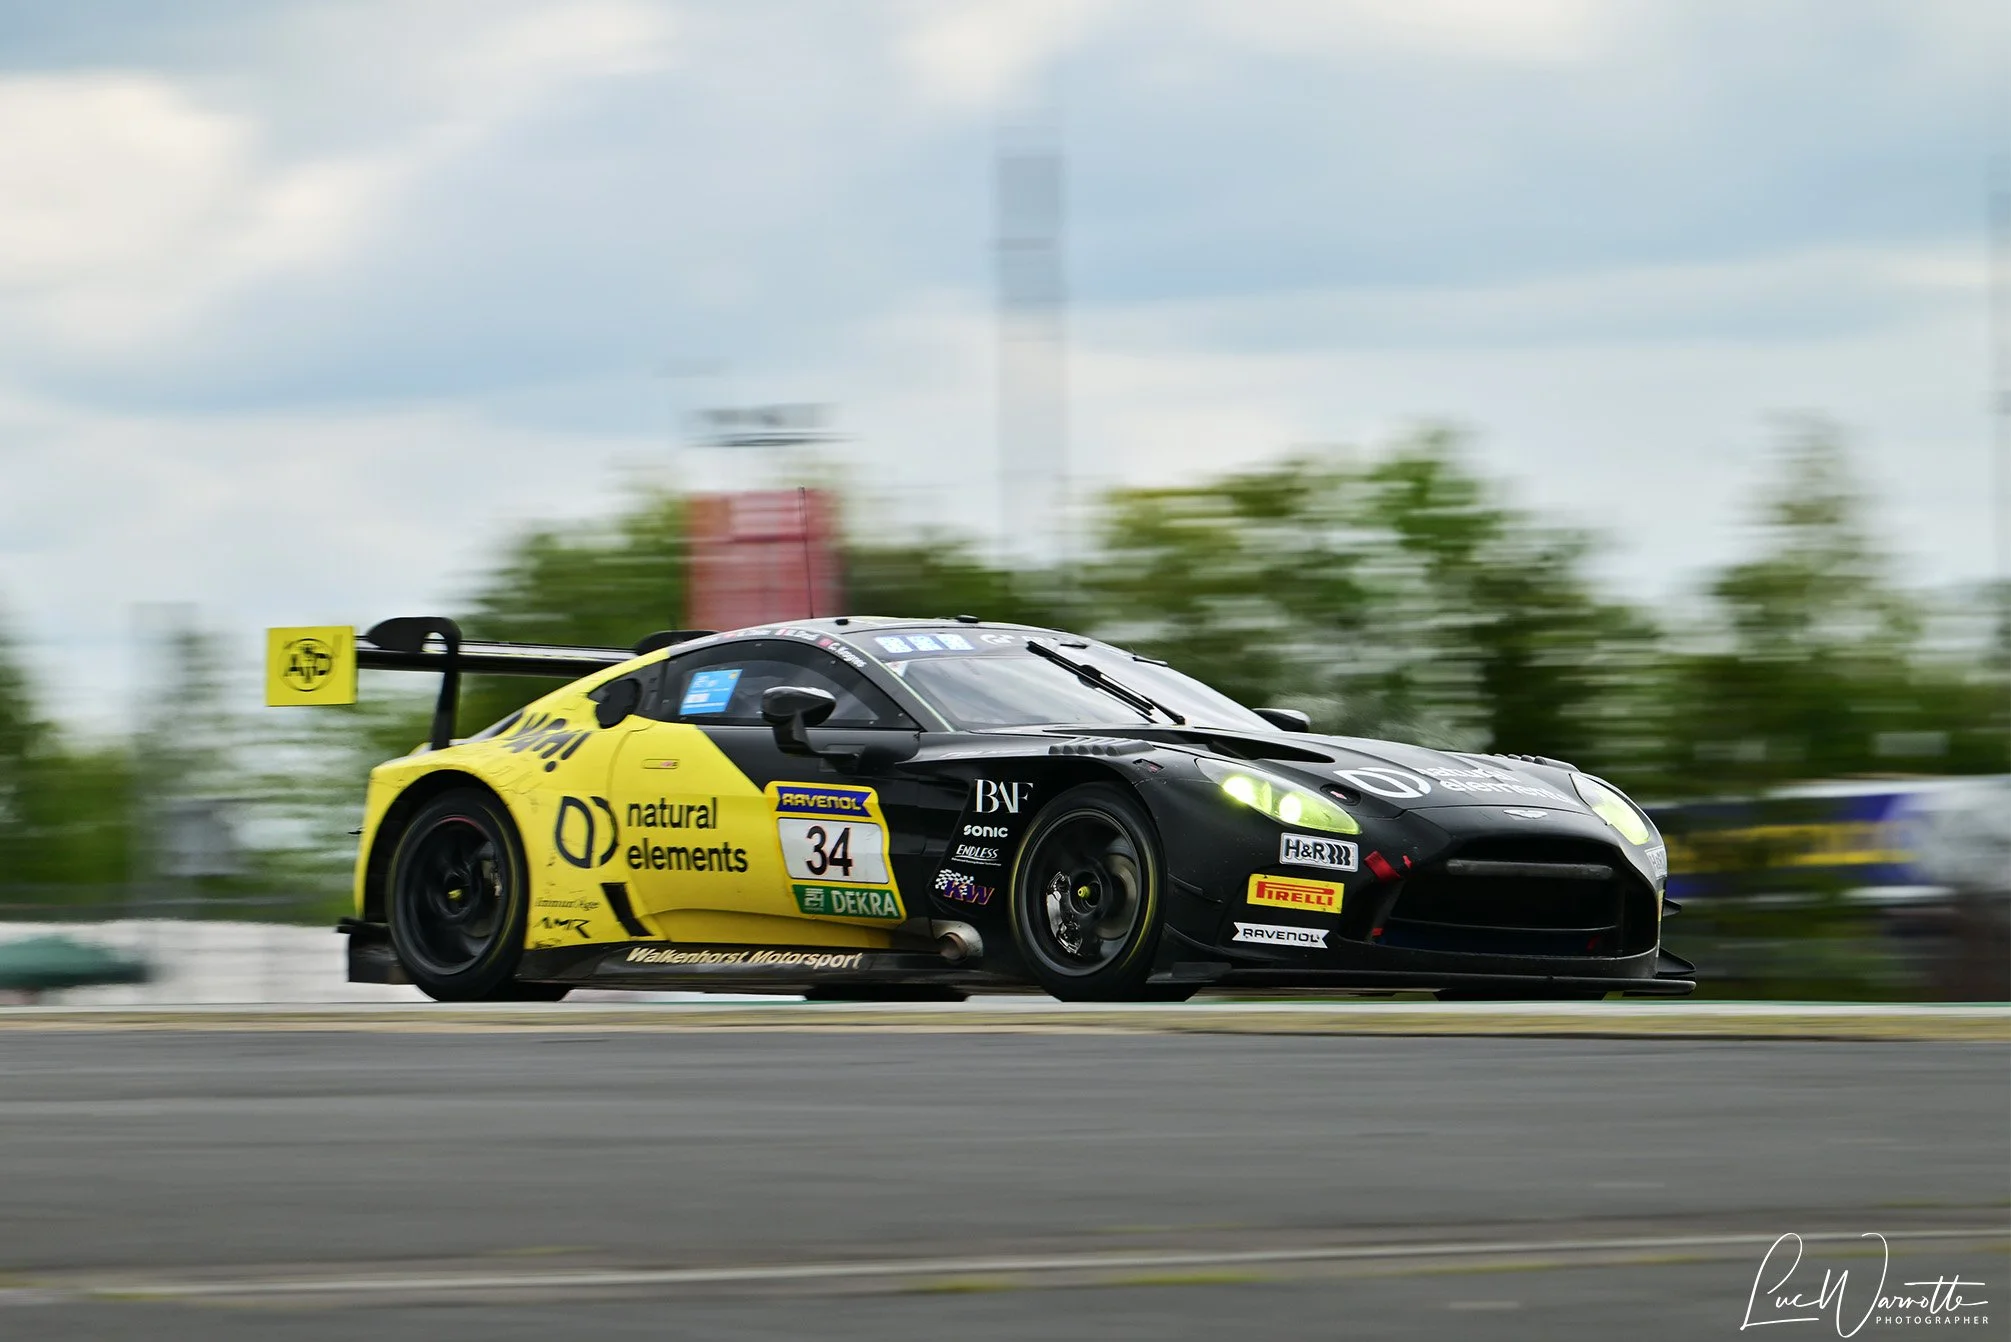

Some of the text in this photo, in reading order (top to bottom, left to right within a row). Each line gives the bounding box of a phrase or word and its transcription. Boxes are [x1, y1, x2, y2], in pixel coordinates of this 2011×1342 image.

[627, 797, 718, 829] natural
[781, 793, 862, 811] RAVENOL
[963, 824, 1009, 838] sonic
[627, 837, 748, 873] elements
[806, 825, 853, 876] 34
[956, 844, 1000, 859] ENDLESS
[1284, 838, 1326, 864] H&R
[831, 889, 899, 917] DEKRA
[943, 879, 996, 905] KW
[1256, 880, 1335, 906] PIRELLI
[1243, 927, 1320, 943] RAVENOL
[626, 947, 864, 970] Walkenhorst Motorsport
